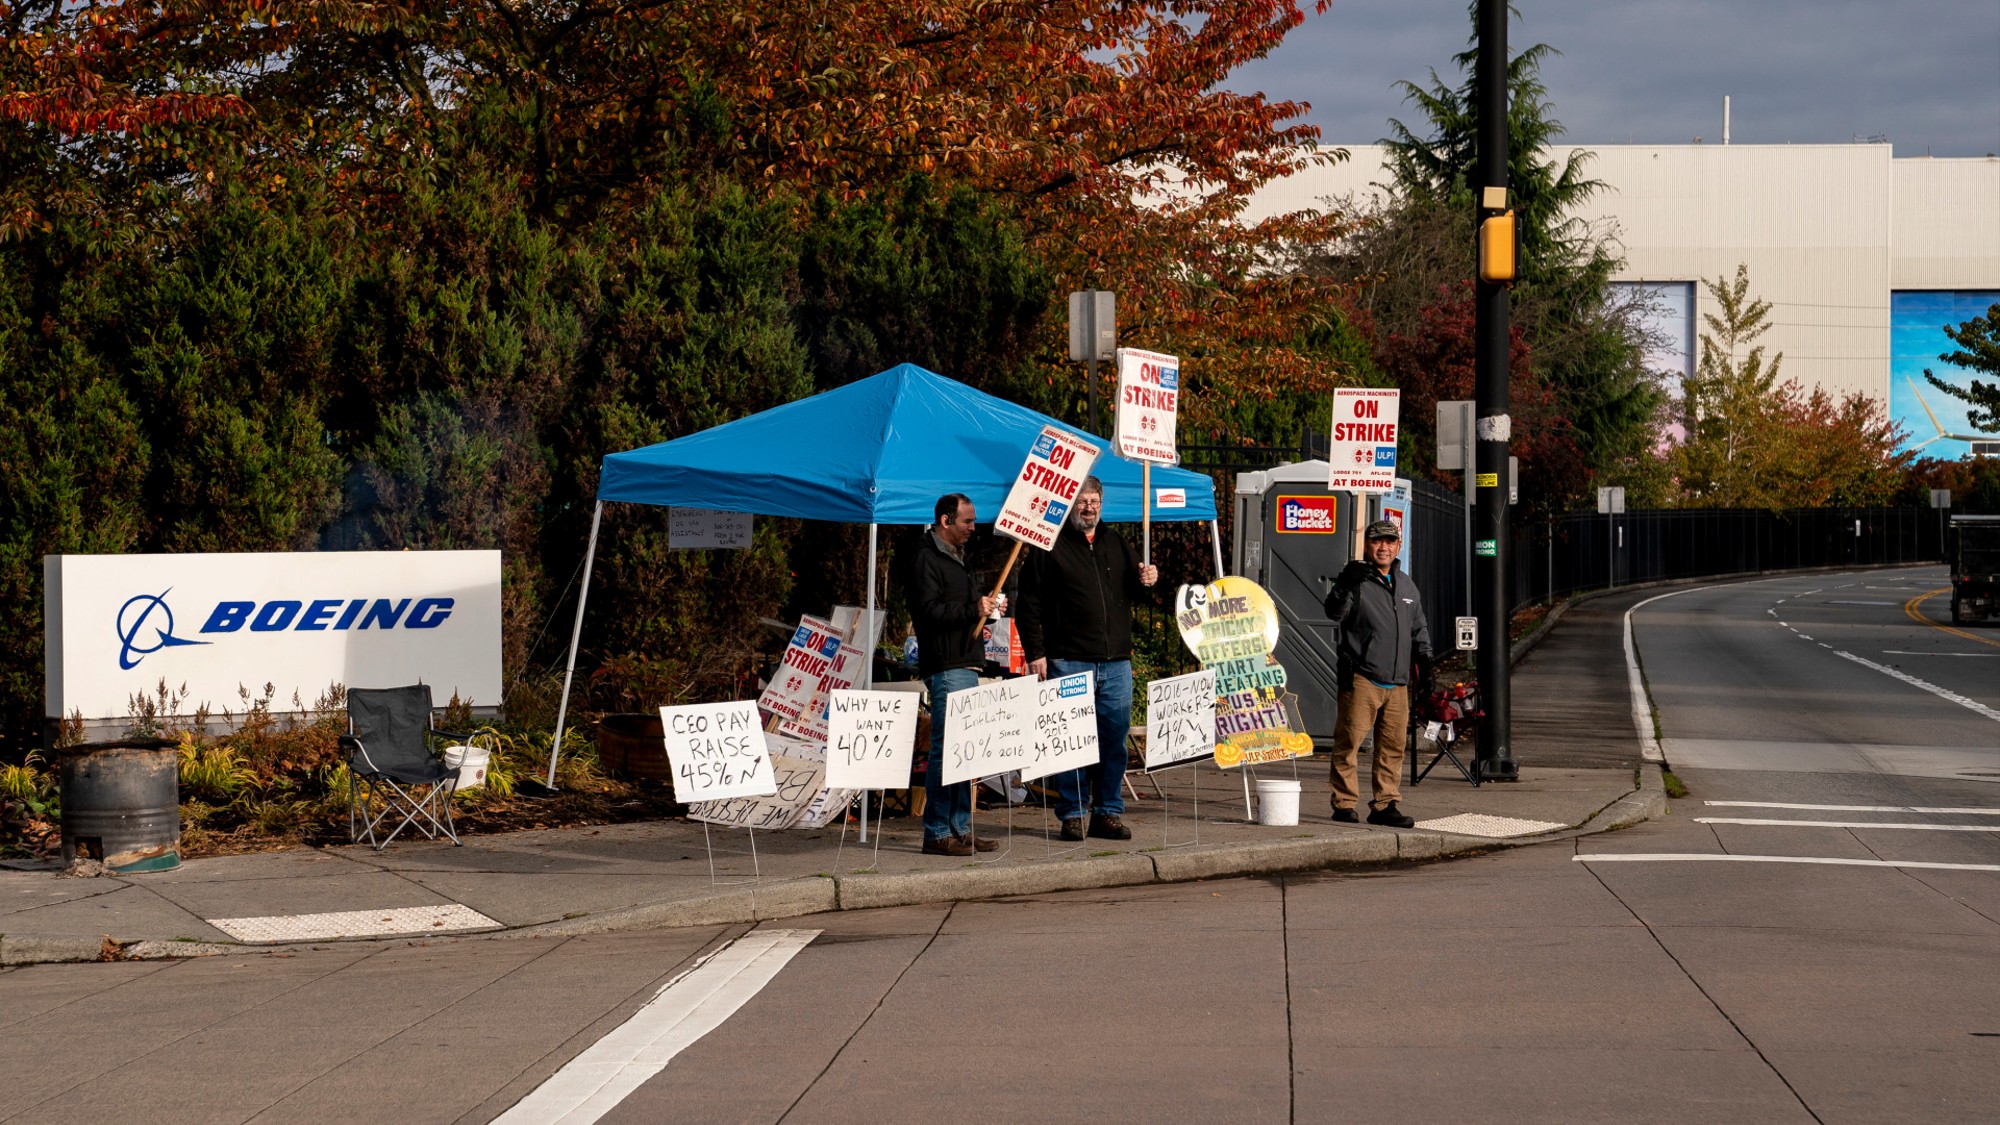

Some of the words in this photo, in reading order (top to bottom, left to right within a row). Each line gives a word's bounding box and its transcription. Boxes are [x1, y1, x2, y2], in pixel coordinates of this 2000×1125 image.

[1151, 355, 1177, 365] MACHINISTS
[1140, 363, 1160, 384] ON
[1124, 384, 1175, 412] STRIKE
[1354, 400, 1378, 418] ON
[1045, 429, 1069, 444] AEROSPACE
[1069, 438, 1096, 456] MACHINISTS
[1335, 423, 1395, 442] STRIKE
[1049, 445, 1076, 470] ON
[1124, 444, 1134, 453] AT
[1137, 446, 1174, 460] BOEING
[1377, 451, 1394, 460] ULP!
[1022, 462, 1079, 500] STRIKE
[1351, 479, 1392, 488] BOEING
[1048, 505, 1064, 518] ULP!
[1286, 505, 1328, 520] Honey
[1286, 517, 1332, 528] Bucket
[1000, 518, 1014, 530] AT
[1015, 525, 1051, 546] BOEING
[199, 598, 454, 633] BOEING
[1178, 608, 1202, 630] NO
[1208, 596, 1248, 618] MORE
[1202, 616, 1255, 640] TRICKY
[806, 631, 829, 653] ON
[1198, 634, 1267, 661] OFFERS!
[783, 647, 829, 678] STRIKE
[1061, 676, 1086, 688] UNION
[1062, 686, 1086, 696] STRONG
[1216, 669, 1284, 694] REATING
[761, 697, 772, 706] AT
[772, 701, 800, 718] BOEING
[835, 696, 868, 713] WHY
[879, 699, 901, 714] WE
[950, 687, 1020, 717] NATIONAL
[1039, 687, 1061, 706] OCK
[1156, 692, 1210, 720] WORKERS
[1231, 693, 1254, 709] US
[672, 714, 708, 734] CEO
[716, 710, 750, 732] PAY
[856, 720, 894, 730] WANT
[1035, 711, 1067, 730] BACK
[1071, 705, 1094, 720] SINCE
[1216, 702, 1286, 735] RIGHT!
[783, 721, 796, 731] AT
[798, 726, 828, 743] BOEING
[1045, 723, 1068, 739] 2013
[1158, 719, 1184, 754] 4%
[689, 736, 754, 760] RAISE
[951, 733, 992, 768] 30%
[999, 745, 1024, 757] 2016
[681, 762, 732, 792] 45%
[754, 805, 790, 827] WE
